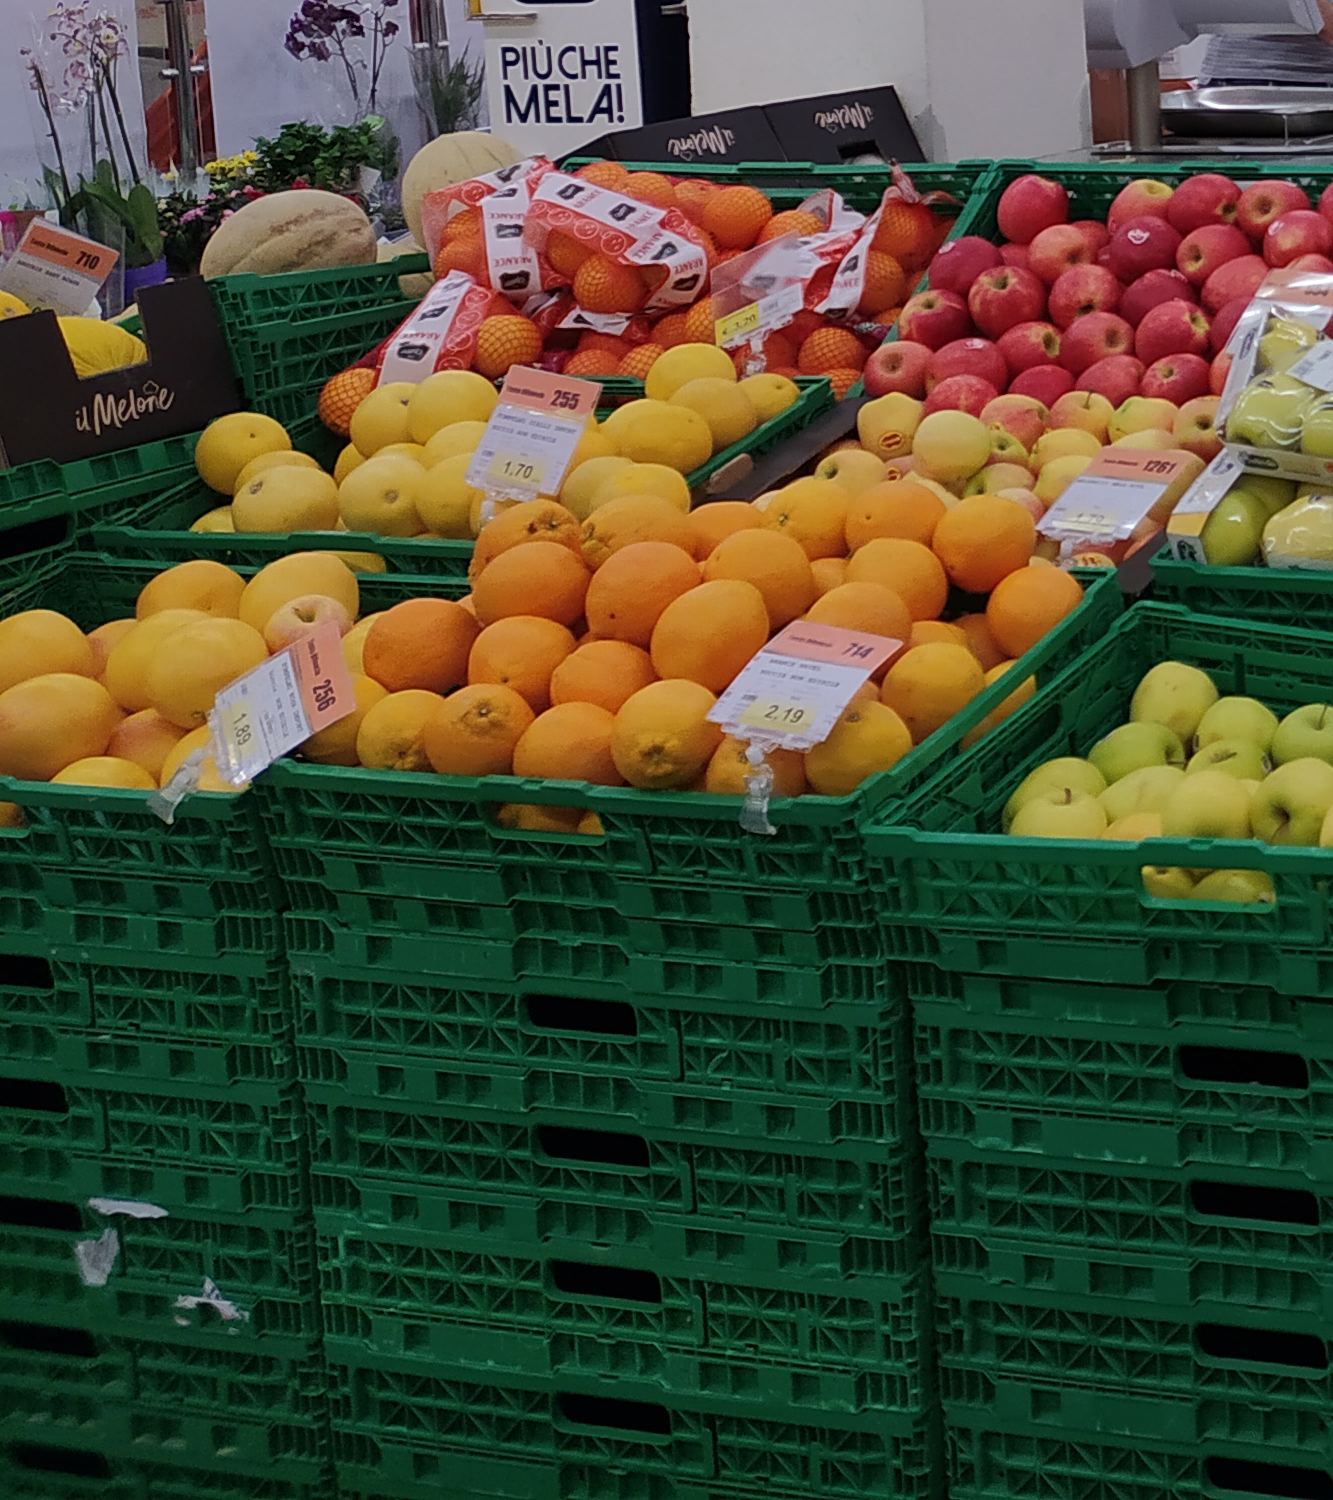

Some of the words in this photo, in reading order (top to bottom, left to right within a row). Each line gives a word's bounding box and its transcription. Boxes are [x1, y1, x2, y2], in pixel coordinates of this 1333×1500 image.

[501, 39, 552, 80] PIÙ
[558, 45, 621, 80] CHE
[503, 83, 625, 124] MELA!
[75, 251, 101, 270] 710
[75, 405, 92, 432] il
[93, 384, 175, 436] Melone
[549, 389, 581, 410] 255
[1142, 460, 1178, 475] 1261
[842, 642, 875, 660] 714
[312, 679, 337, 713] 256
[764, 704, 805, 724] 2,19
